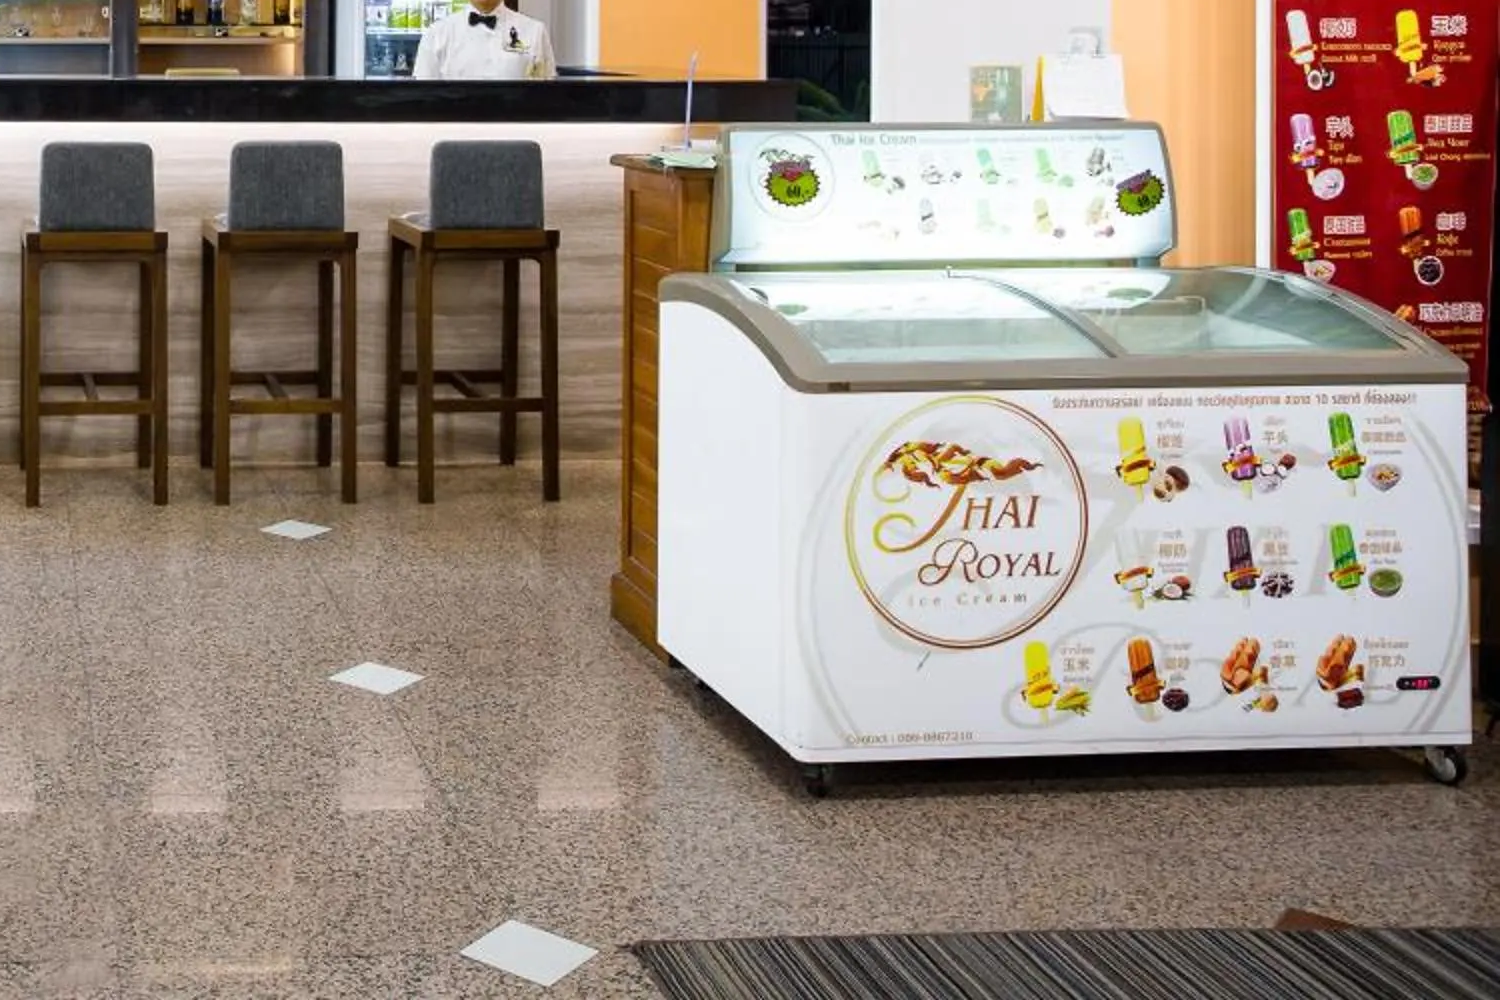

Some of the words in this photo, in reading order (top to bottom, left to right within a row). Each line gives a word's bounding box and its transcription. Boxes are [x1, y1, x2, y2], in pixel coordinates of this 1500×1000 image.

[1316, 393, 1329, 405] 10
[872, 438, 1042, 554] THAI
[918, 537, 1061, 587] ROYAL
